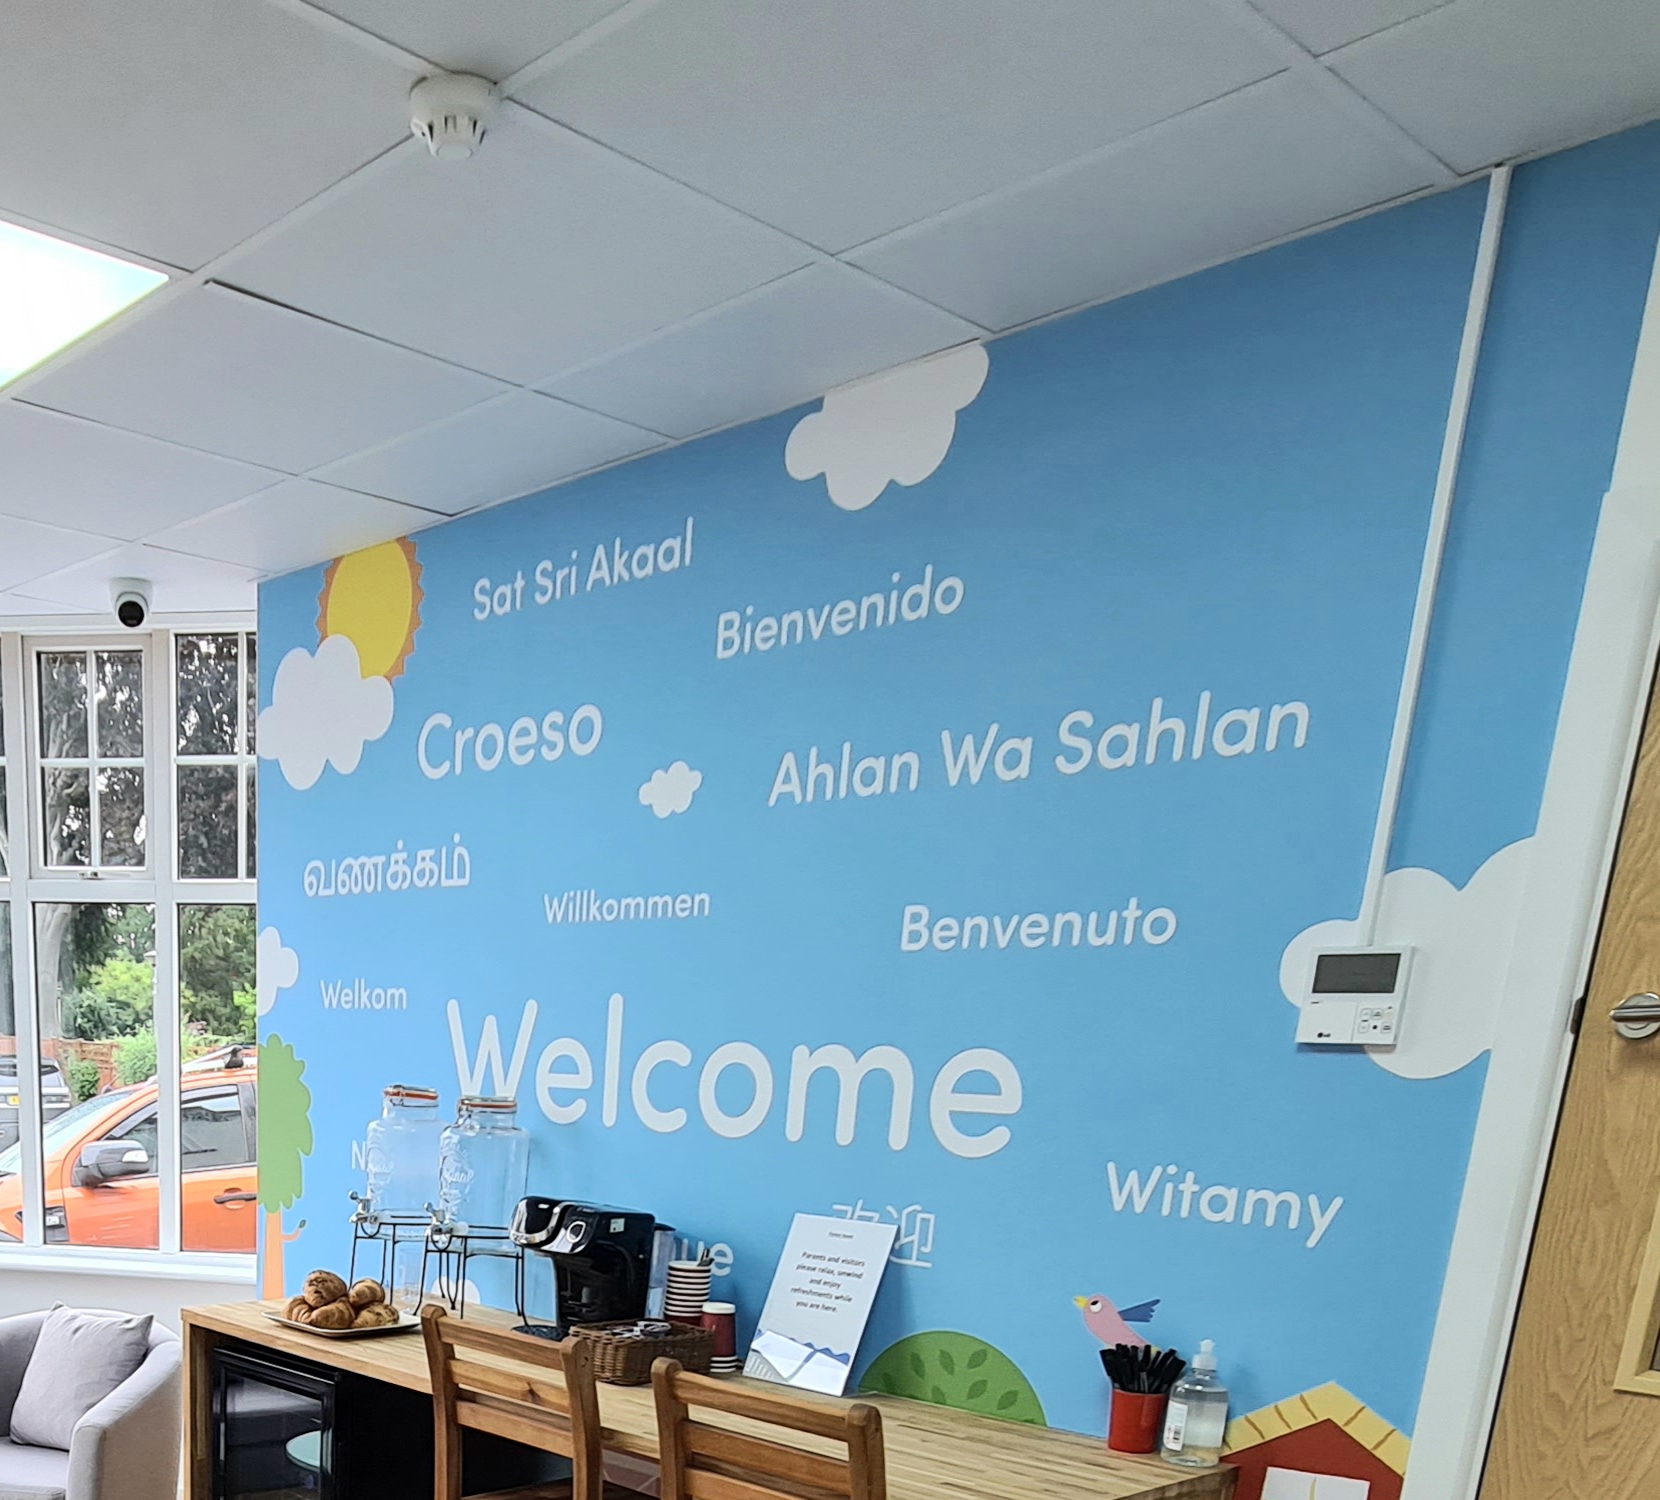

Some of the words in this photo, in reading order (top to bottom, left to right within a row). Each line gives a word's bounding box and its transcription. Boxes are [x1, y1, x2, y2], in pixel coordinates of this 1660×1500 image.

[472, 572, 527, 622] Sat
[534, 550, 578, 606] Sri
[585, 516, 695, 593] Akaal
[715, 564, 967, 661] Bienvenido
[416, 702, 605, 781] Croeso
[767, 740, 921, 809] Ahlan
[940, 721, 1034, 788] Wa
[1054, 690, 1312, 777] Sahlan
[301, 831, 473, 899] வணக்கம்
[542, 889, 712, 925] Willkommen
[899, 896, 1179, 953] Benvenuto
[319, 977, 409, 1011] Welkom
[445, 992, 1024, 1160] Welcome
[1105, 1160, 1345, 1251] Witamy
[795, 1263, 817, 1272] please
[818, 1266, 836, 1276] relax,
[837, 1269, 864, 1279] unwind
[801, 1250, 827, 1261] Parents
[841, 1257, 866, 1267] visitors
[809, 1277, 823, 1285] and
[822, 1280, 842, 1290] enjoy
[790, 1287, 833, 1299] refreshments
[834, 1293, 853, 1303] while
[821, 1303, 838, 1313] here.
